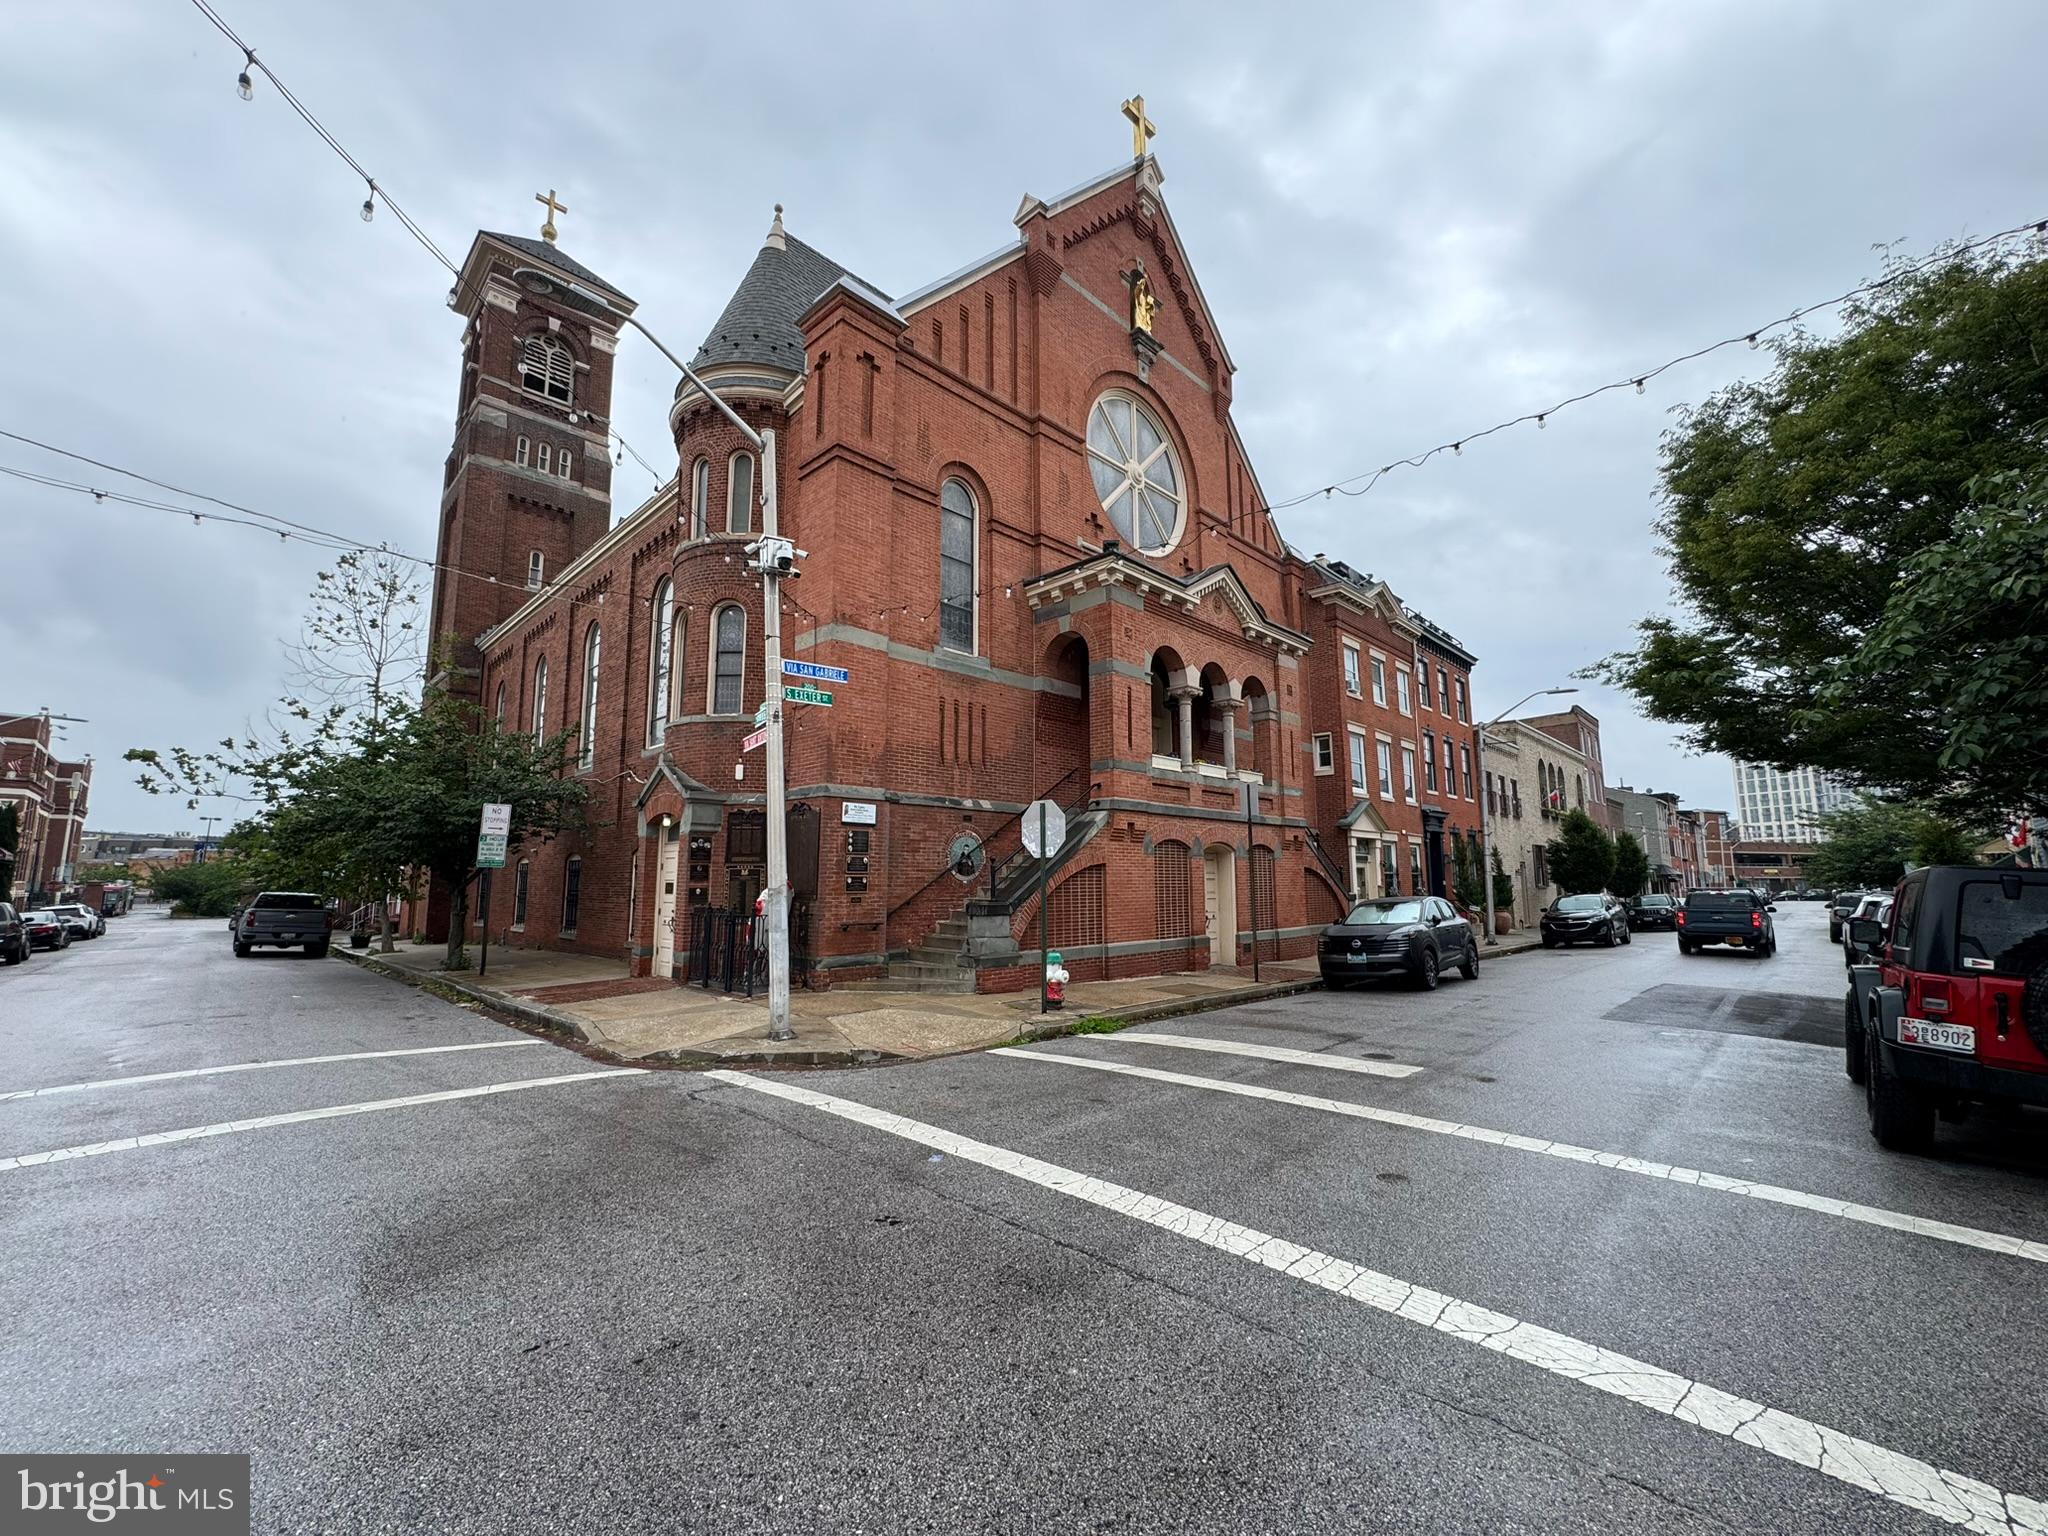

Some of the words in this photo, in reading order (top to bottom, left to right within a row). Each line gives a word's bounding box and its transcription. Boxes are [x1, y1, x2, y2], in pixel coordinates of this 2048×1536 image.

[786, 662, 798, 673] VIA
[800, 664, 814, 675] SAN
[815, 667, 845, 681] GABRIELE
[794, 690, 822, 702] EXETER
[484, 816, 507, 824] STOPPING
